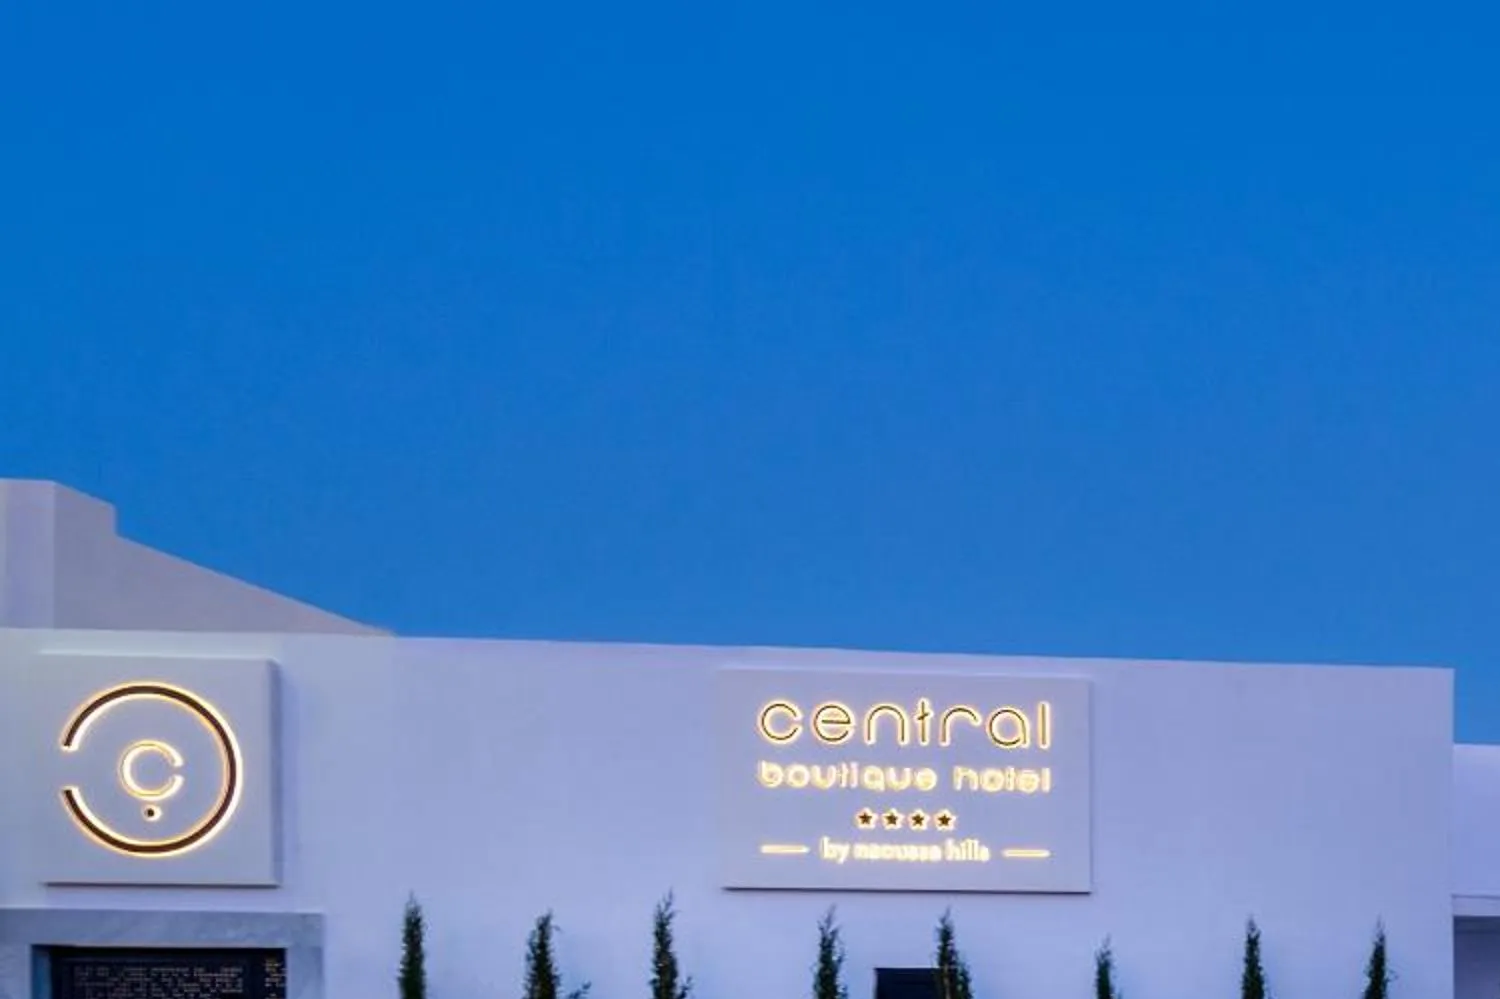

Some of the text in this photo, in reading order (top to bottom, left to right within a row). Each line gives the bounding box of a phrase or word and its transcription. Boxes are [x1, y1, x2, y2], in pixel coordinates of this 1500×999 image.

[760, 699, 1051, 749] central
[759, 761, 1052, 793] boutique hotel
[822, 836, 850, 864] by
